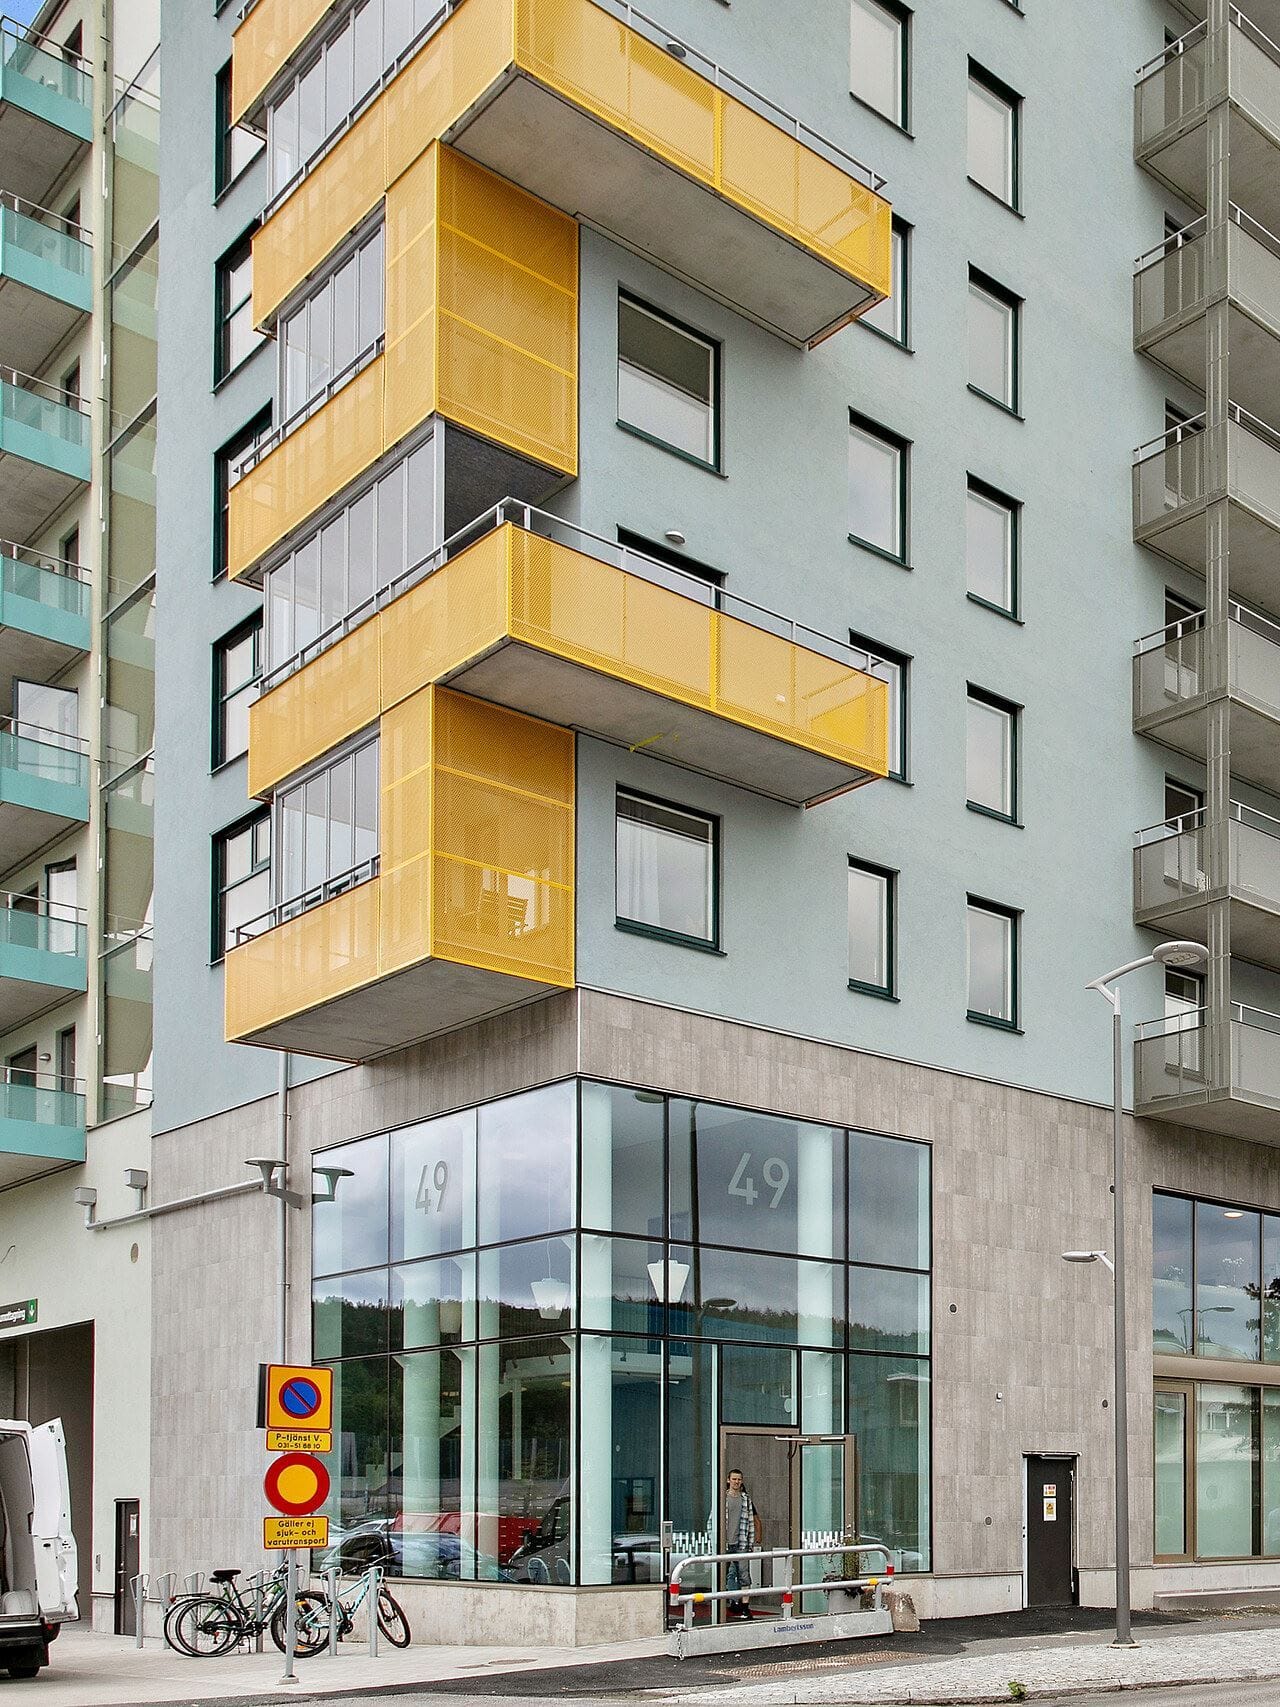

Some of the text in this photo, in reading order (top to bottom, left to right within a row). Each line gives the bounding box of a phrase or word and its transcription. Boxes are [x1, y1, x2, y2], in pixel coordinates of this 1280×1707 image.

[728, 1152, 791, 1209] 49
[415, 1160, 449, 1215] 49
[276, 1433, 310, 1443] P-tjänst
[278, 1520, 315, 1528] Gäller ej
[276, 1528, 299, 1537] sjuk-
[267, 1537, 325, 1546] varutransport
